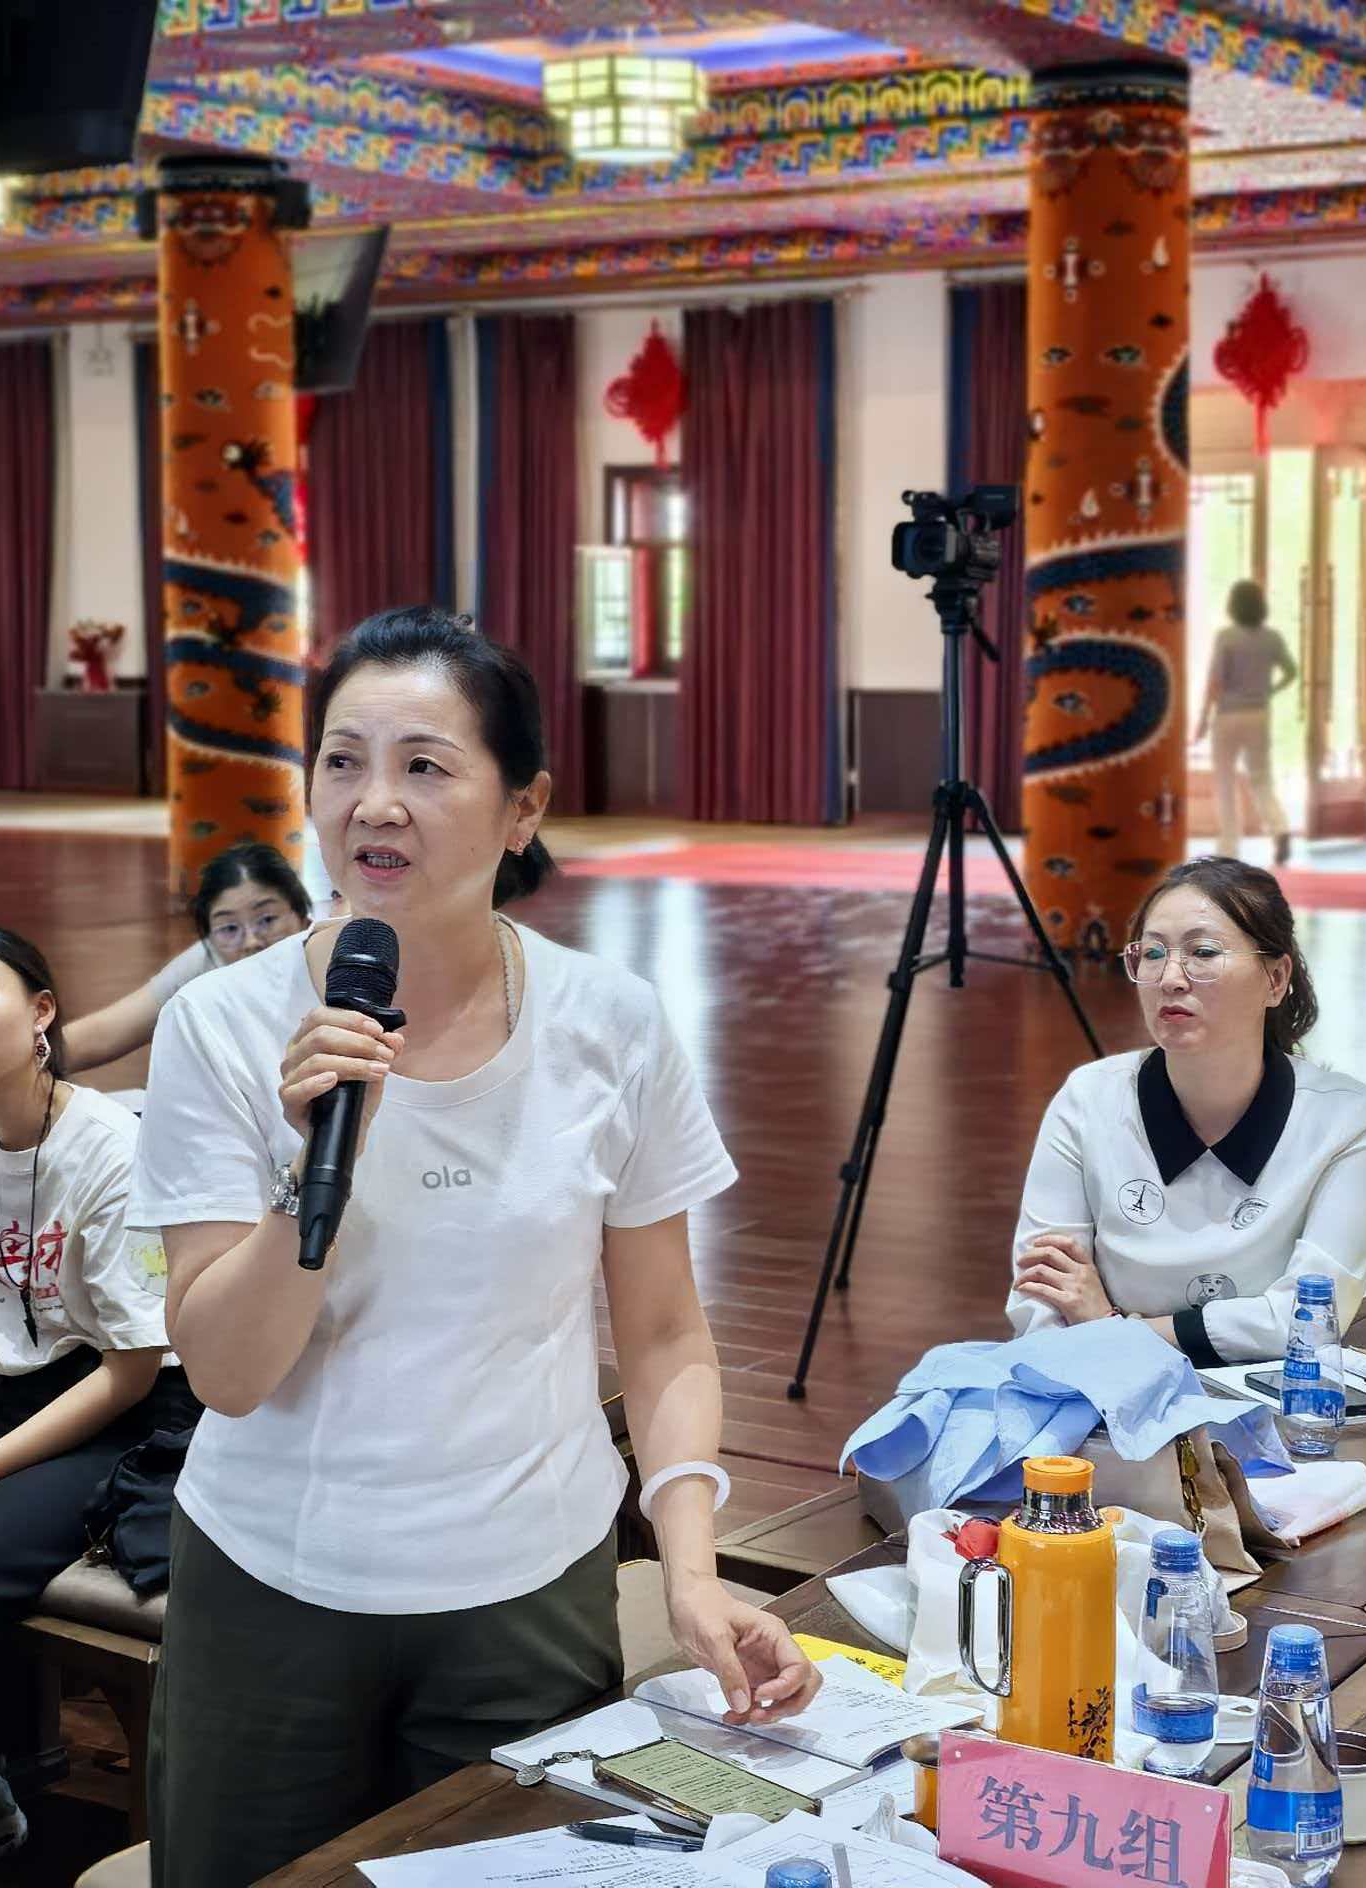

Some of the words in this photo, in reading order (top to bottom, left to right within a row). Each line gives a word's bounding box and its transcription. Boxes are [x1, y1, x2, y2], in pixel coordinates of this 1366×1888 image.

[421, 1165, 473, 1190] ola
[977, 1775, 1188, 1888] 第九组
